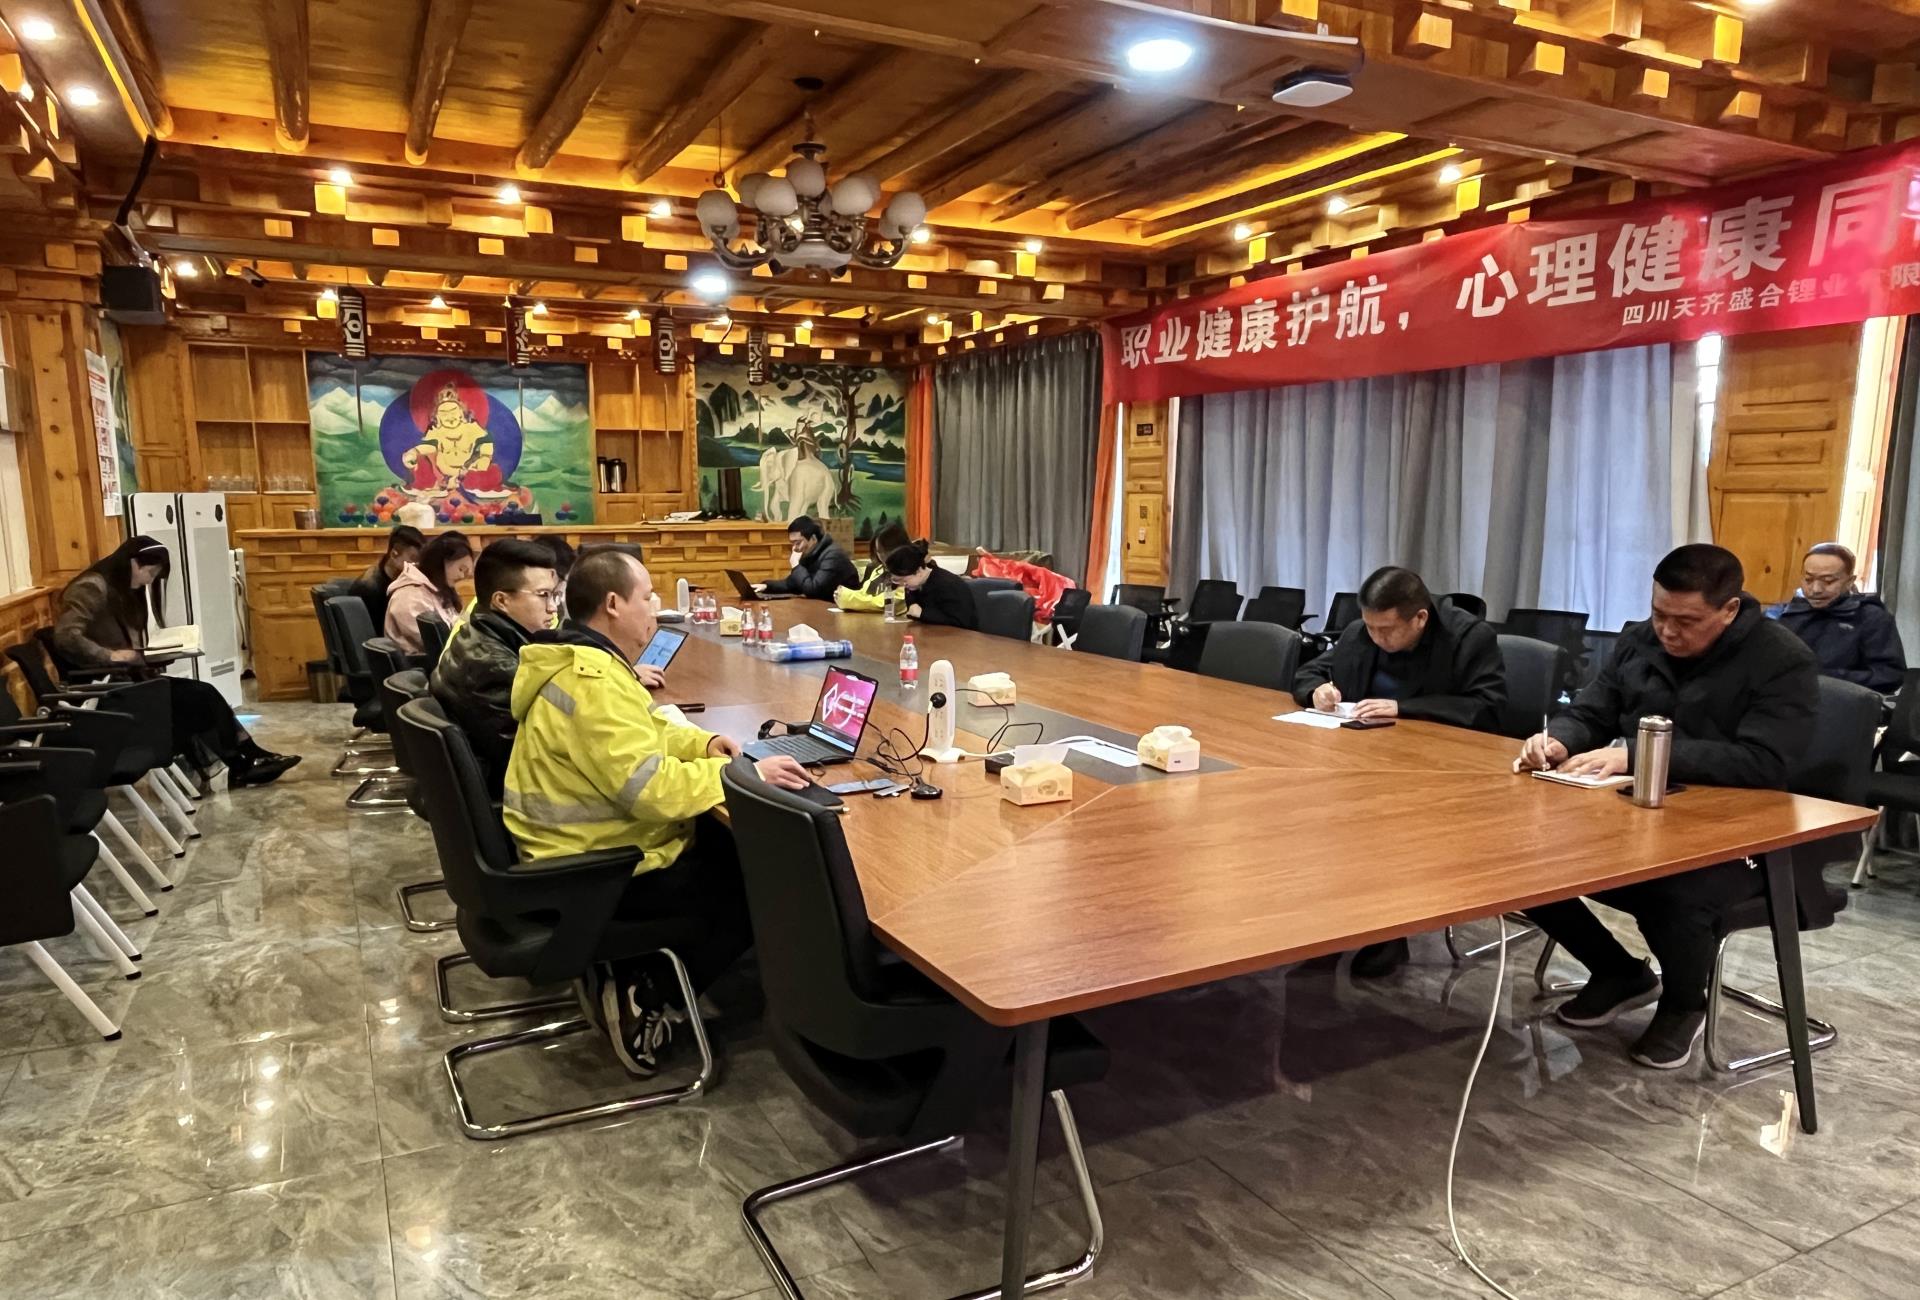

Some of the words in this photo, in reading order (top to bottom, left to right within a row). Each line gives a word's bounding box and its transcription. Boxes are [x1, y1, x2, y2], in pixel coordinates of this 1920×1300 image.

[1120, 166, 1920, 369] 职业健康护航，心理健康同
